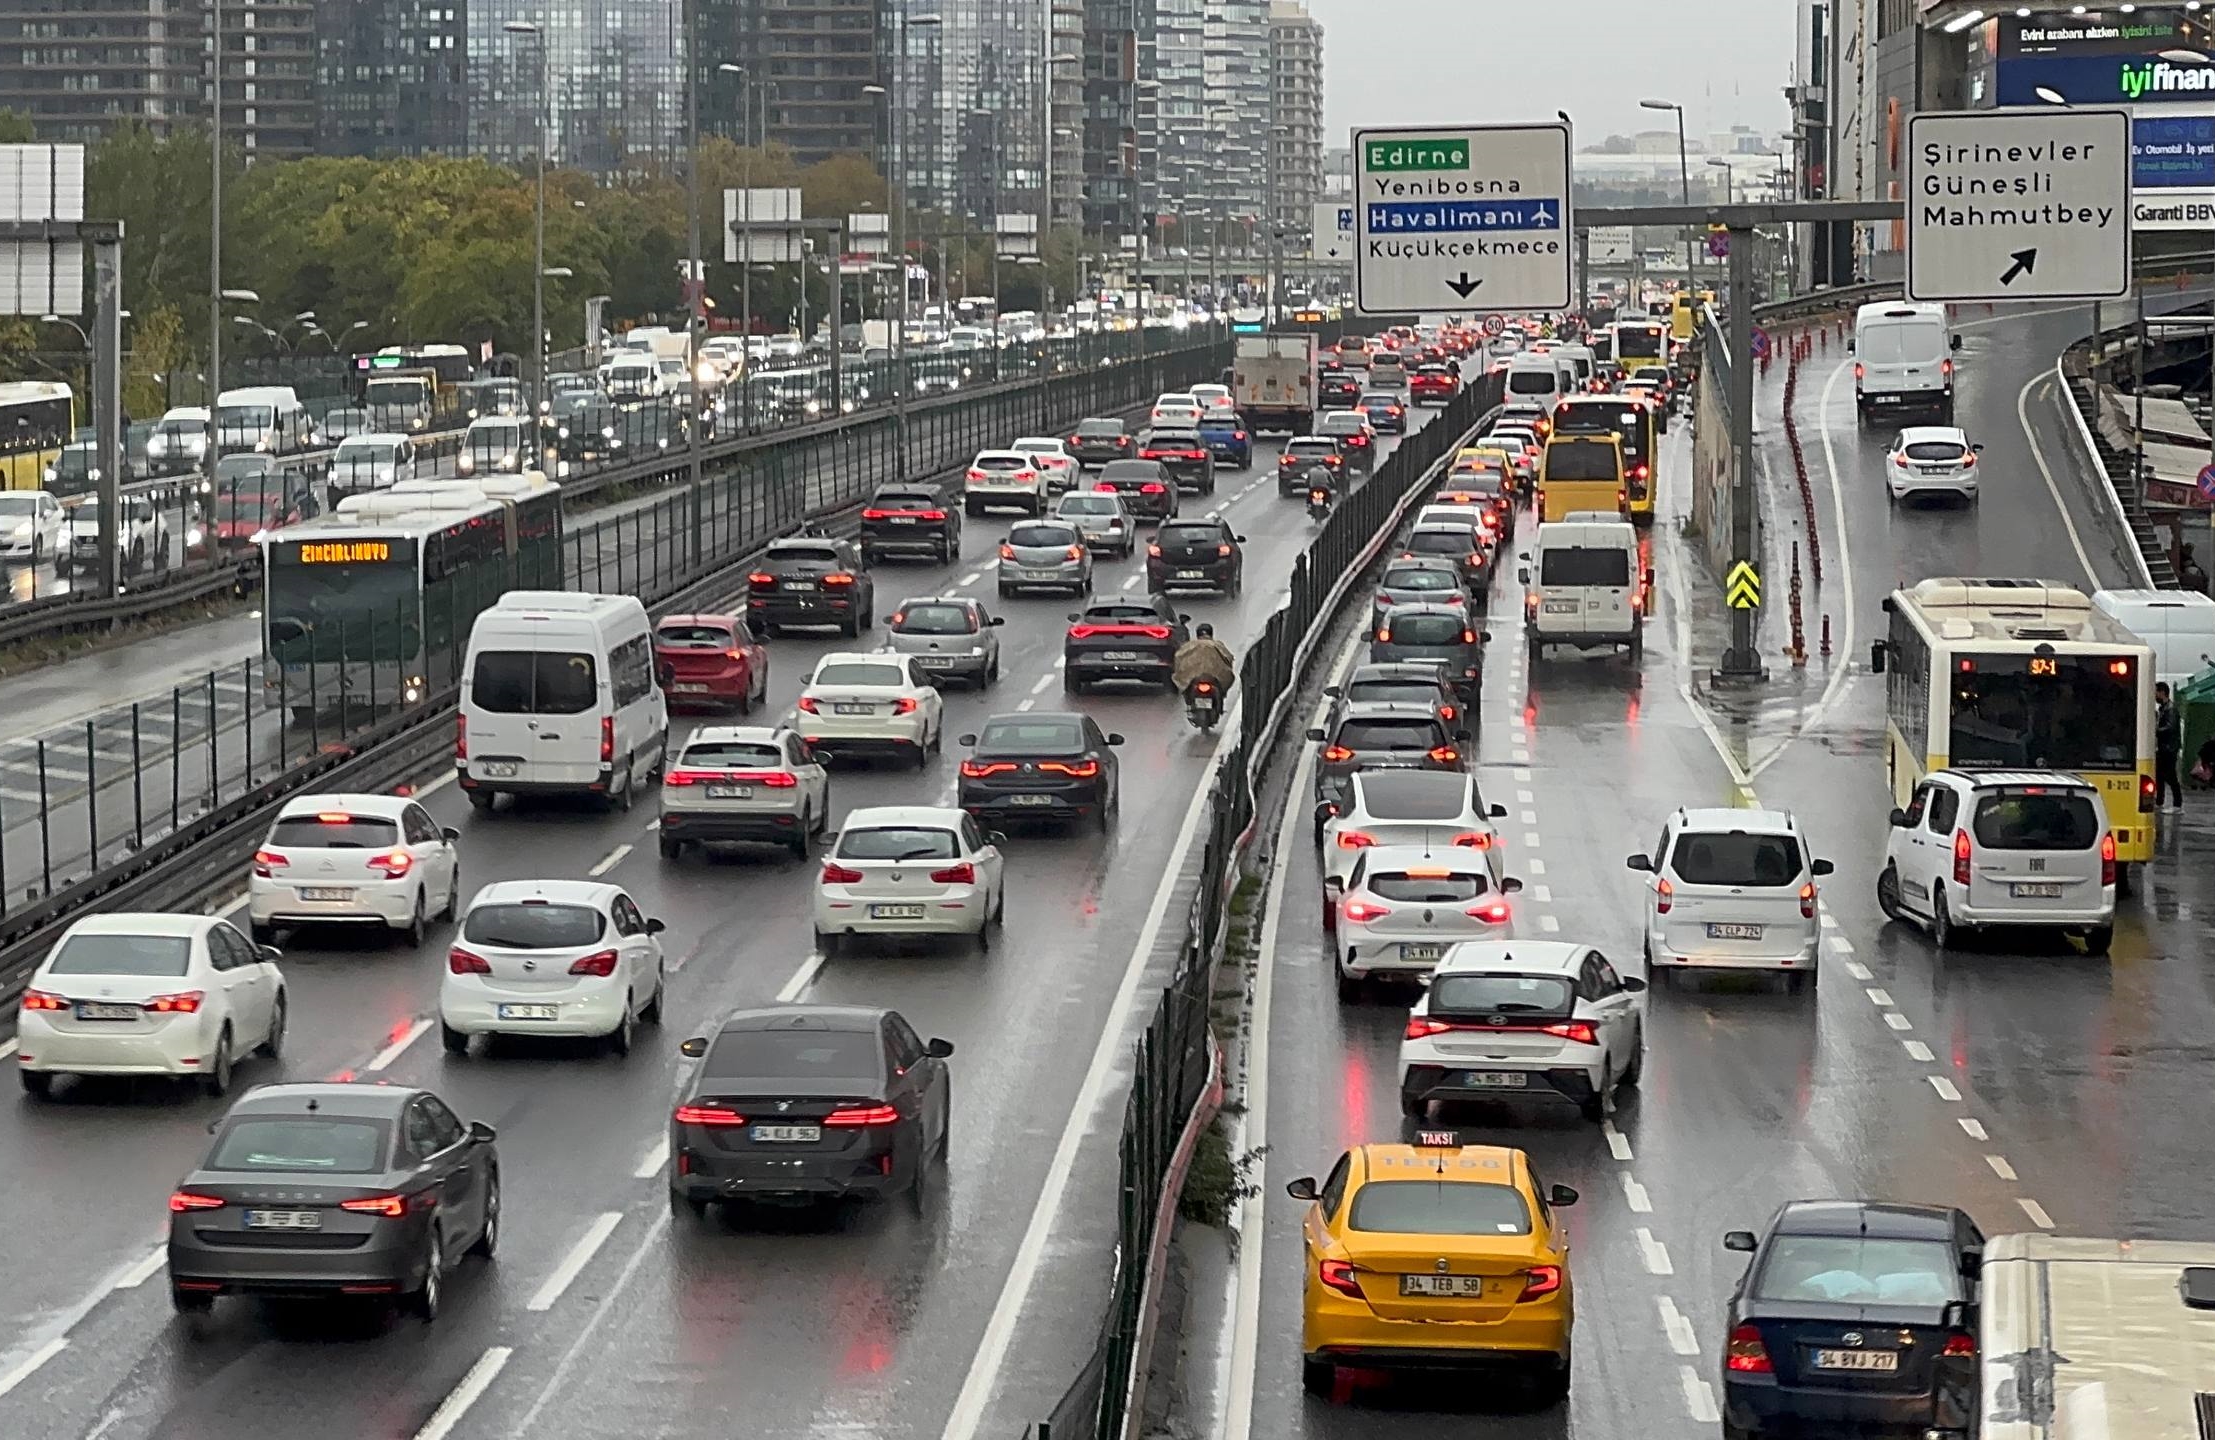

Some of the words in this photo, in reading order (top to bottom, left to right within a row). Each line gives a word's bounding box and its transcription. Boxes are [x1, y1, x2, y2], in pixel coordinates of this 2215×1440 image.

[2020, 28, 2045, 41] Evini
[1371, 147, 1464, 166] Edirne
[1924, 140, 2095, 167] Şirinevler
[2145, 144, 2182, 155] Otomobil
[1375, 177, 1521, 196] Yenibosna
[1924, 172, 2051, 196] Güneşli
[1371, 207, 1522, 228] Havalimanı
[1924, 203, 2113, 228] Mahmutbey
[2134, 204, 2183, 220] Garanti
[1369, 238, 1560, 259] Küçükçekmece
[1488, 320, 1500, 331] 50
[2029, 858, 2046, 871] FIAT
[1712, 926, 1722, 935] 34
[1725, 926, 1741, 935] CLP
[1744, 927, 1759, 936] 724
[1408, 1276, 1423, 1290] 34
[1431, 1277, 1453, 1291] TEB
[1463, 1277, 1478, 1291] 58
[1820, 1351, 1835, 1365] 34
[1871, 1353, 1894, 1367] 217
